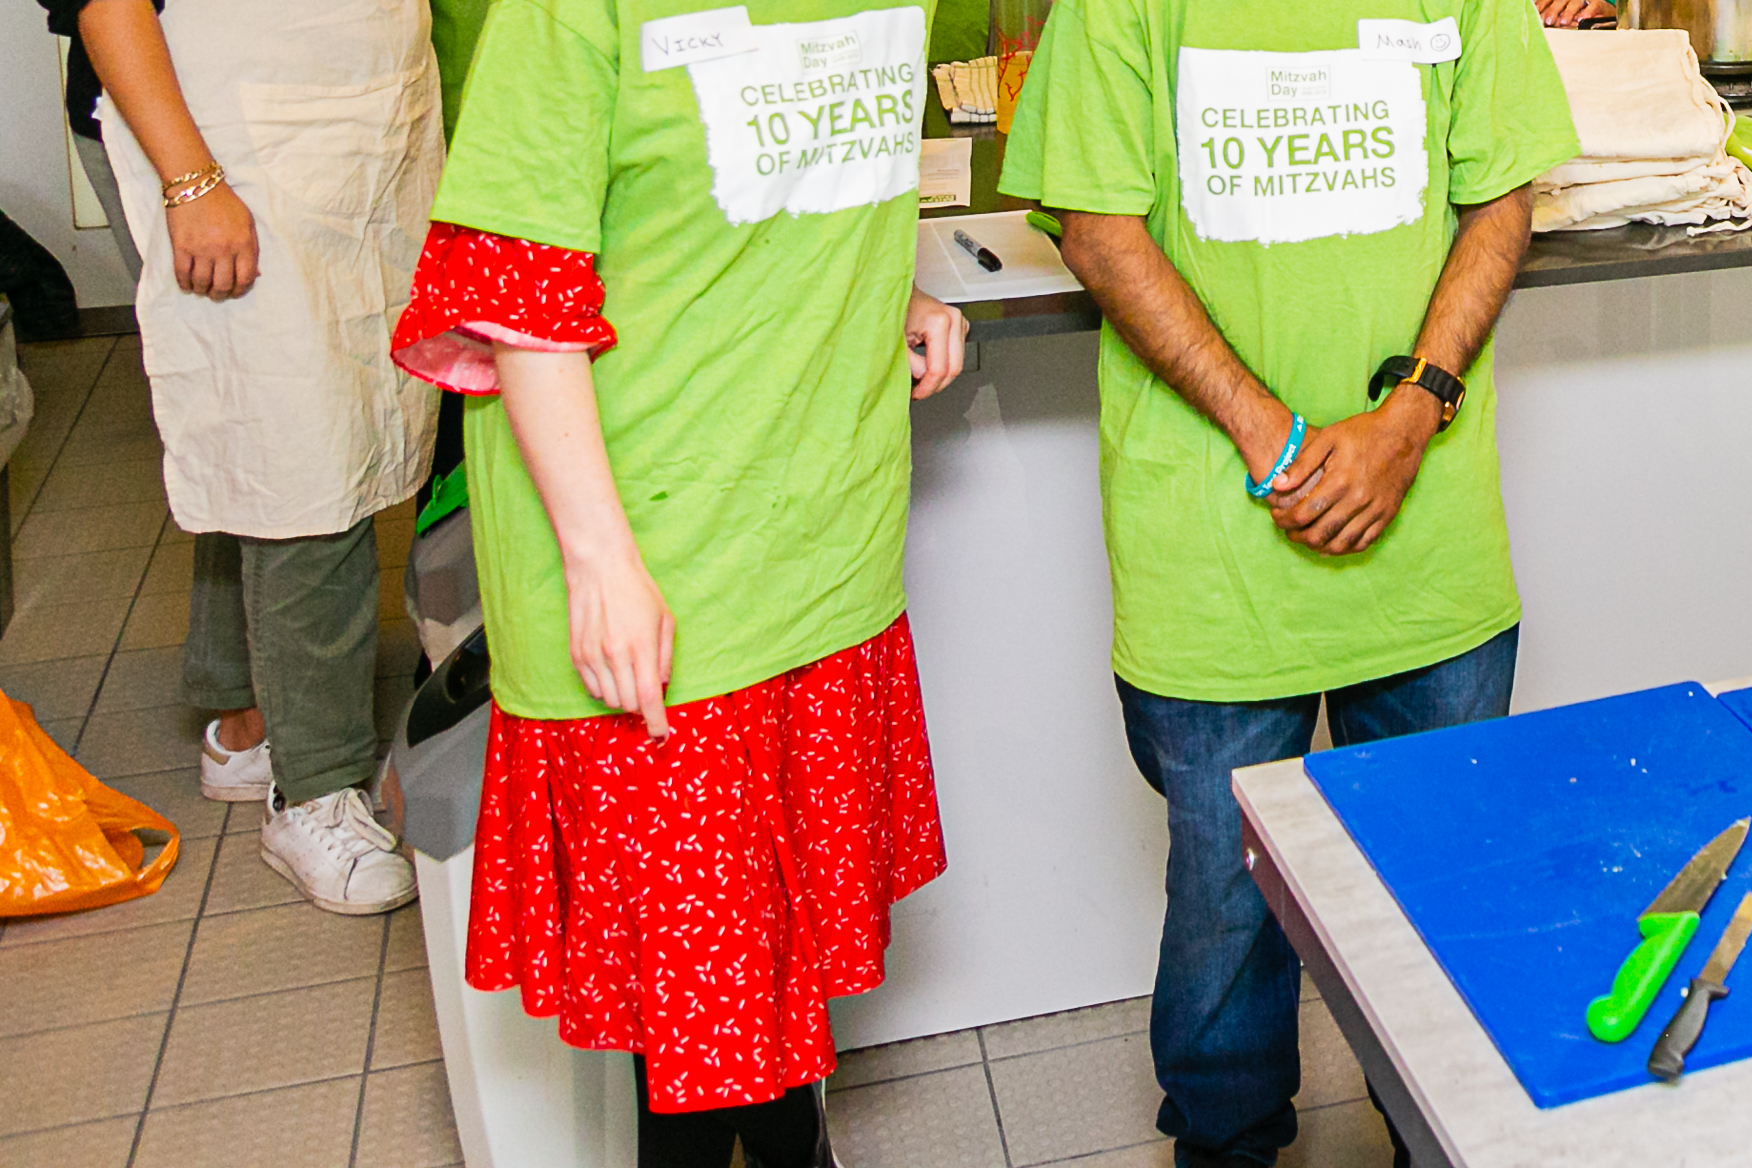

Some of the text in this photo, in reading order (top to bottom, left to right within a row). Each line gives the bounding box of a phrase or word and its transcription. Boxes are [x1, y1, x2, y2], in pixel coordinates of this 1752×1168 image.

[800, 35, 857, 55] Mitzvah
[803, 55, 828, 70] Day
[1270, 69, 1327, 83] Mitzvah
[740, 62, 914, 106] CELEBRATING
[1270, 84, 1298, 97] Day
[747, 89, 914, 147] 10 YEARS
[1201, 100, 1389, 129] CELEBRATING
[756, 131, 914, 175] OF MITZVAHS
[1201, 126, 1395, 170] 10 YEARS
[1206, 166, 1396, 197] OF MITZVAHS
